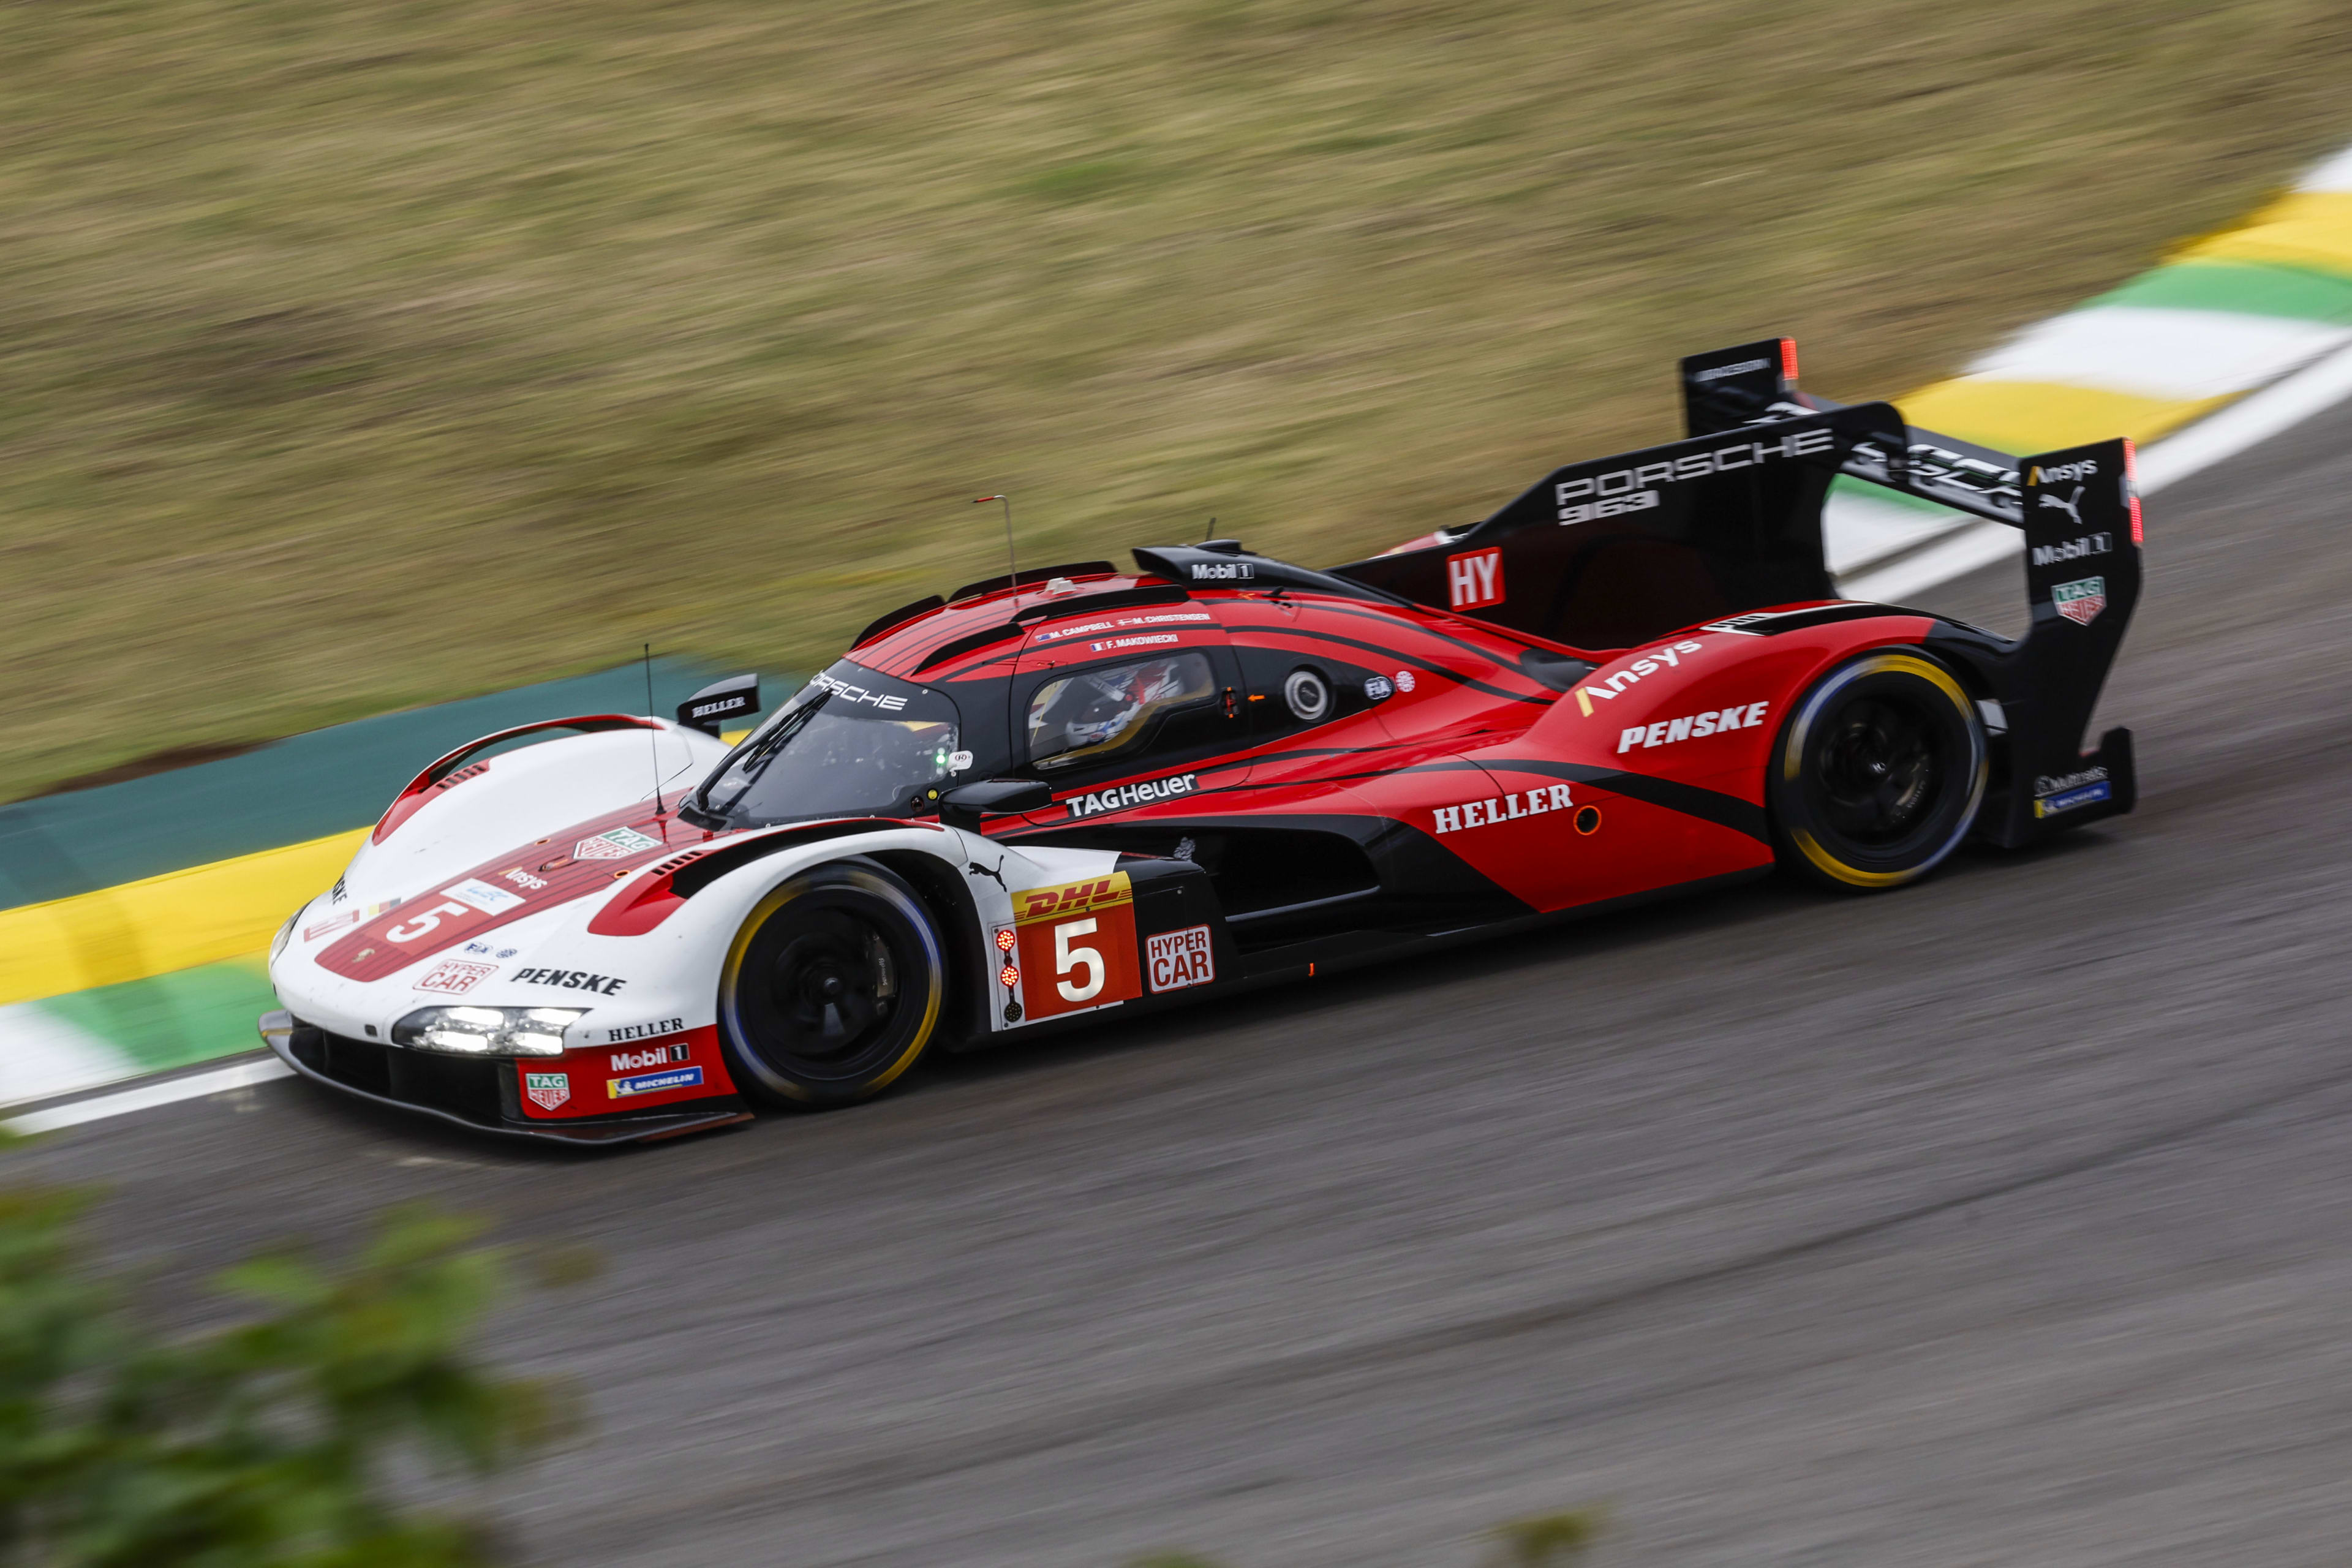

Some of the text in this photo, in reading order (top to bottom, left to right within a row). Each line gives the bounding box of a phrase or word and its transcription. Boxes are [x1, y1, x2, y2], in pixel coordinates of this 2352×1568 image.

[1556, 428, 1834, 505] PORSCHE
[2027, 459, 2098, 486] Ansys
[1557, 491, 1659, 526] 963
[2032, 537, 2090, 565] Mobil
[1191, 564, 1237, 579] Mobil
[1449, 553, 1499, 606] HY
[2056, 581, 2100, 601] TAG
[1063, 621, 1115, 636] CAMPBELL
[1117, 634, 1178, 648] MAKOWIECKI
[810, 670, 908, 711] ORSCHE
[1575, 638, 1702, 717] Ansys
[692, 696, 745, 718] HELLER
[1617, 701, 1768, 753] PENSKE
[1433, 784, 1573, 834] HELLER
[608, 831, 656, 850] TAG
[498, 866, 548, 889] Ansys
[1025, 880, 1120, 918] DHL
[386, 901, 469, 943] 5
[1150, 930, 1207, 959] HYPER
[438, 961, 491, 976] HYPER
[1055, 917, 1106, 1002] 5
[1153, 950, 1209, 987] CAR
[421, 971, 477, 992] CAR
[510, 967, 627, 997] PENSKE
[608, 1018, 684, 1042] HELLER
[610, 1047, 668, 1071] Mobil
[529, 1076, 564, 1087] TAG
[635, 1073, 695, 1090] MICHELIN
[530, 1089, 567, 1109] HEUER
